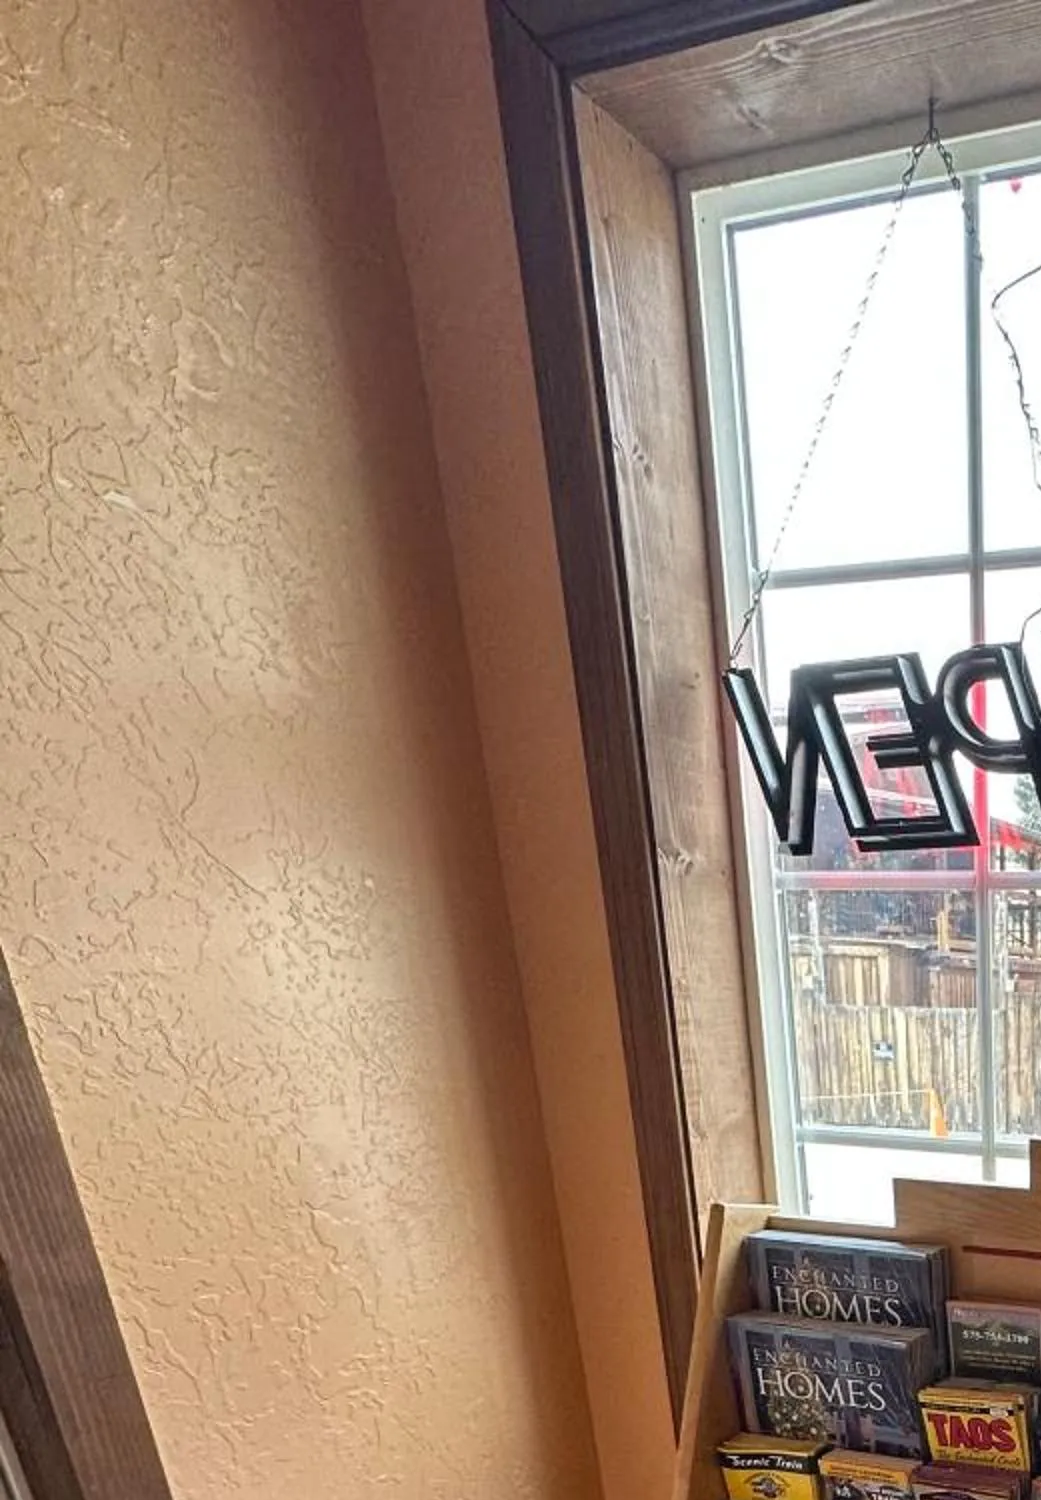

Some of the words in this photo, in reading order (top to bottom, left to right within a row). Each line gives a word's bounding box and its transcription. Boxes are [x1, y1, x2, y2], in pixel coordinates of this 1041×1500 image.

[773, 1265, 899, 1293] ENCHANTED
[774, 1284, 902, 1327] HOMES
[753, 1347, 882, 1378] ENCHANTED
[756, 1367, 887, 1412] HOMES
[927, 1412, 1017, 1453] TAOS
[728, 1455, 769, 1468] Scenic
[770, 1456, 804, 1470] Train
